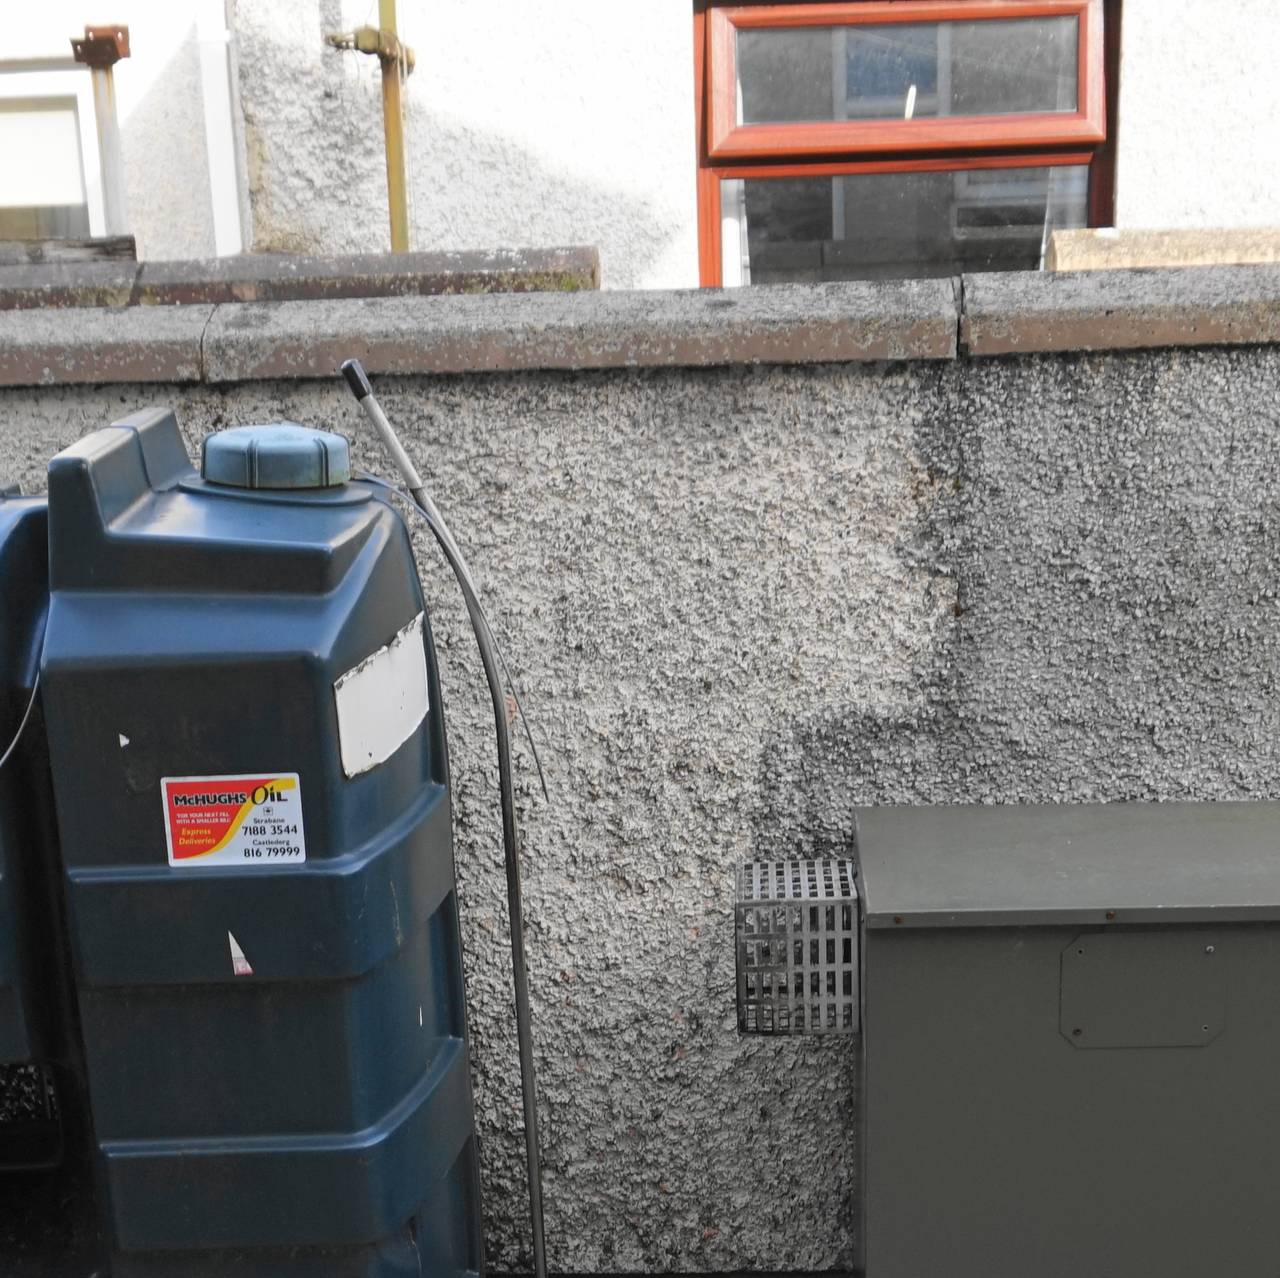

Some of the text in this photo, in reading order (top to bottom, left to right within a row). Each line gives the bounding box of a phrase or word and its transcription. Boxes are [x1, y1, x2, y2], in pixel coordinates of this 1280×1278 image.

[174, 793, 247, 806] McHUGHS
[182, 827, 211, 836] Express
[242, 824, 298, 836] 7188 3544
[179, 837, 216, 845] Deliveries
[252, 839, 290, 847] Castlederg
[244, 846, 300, 858] 816 79999
